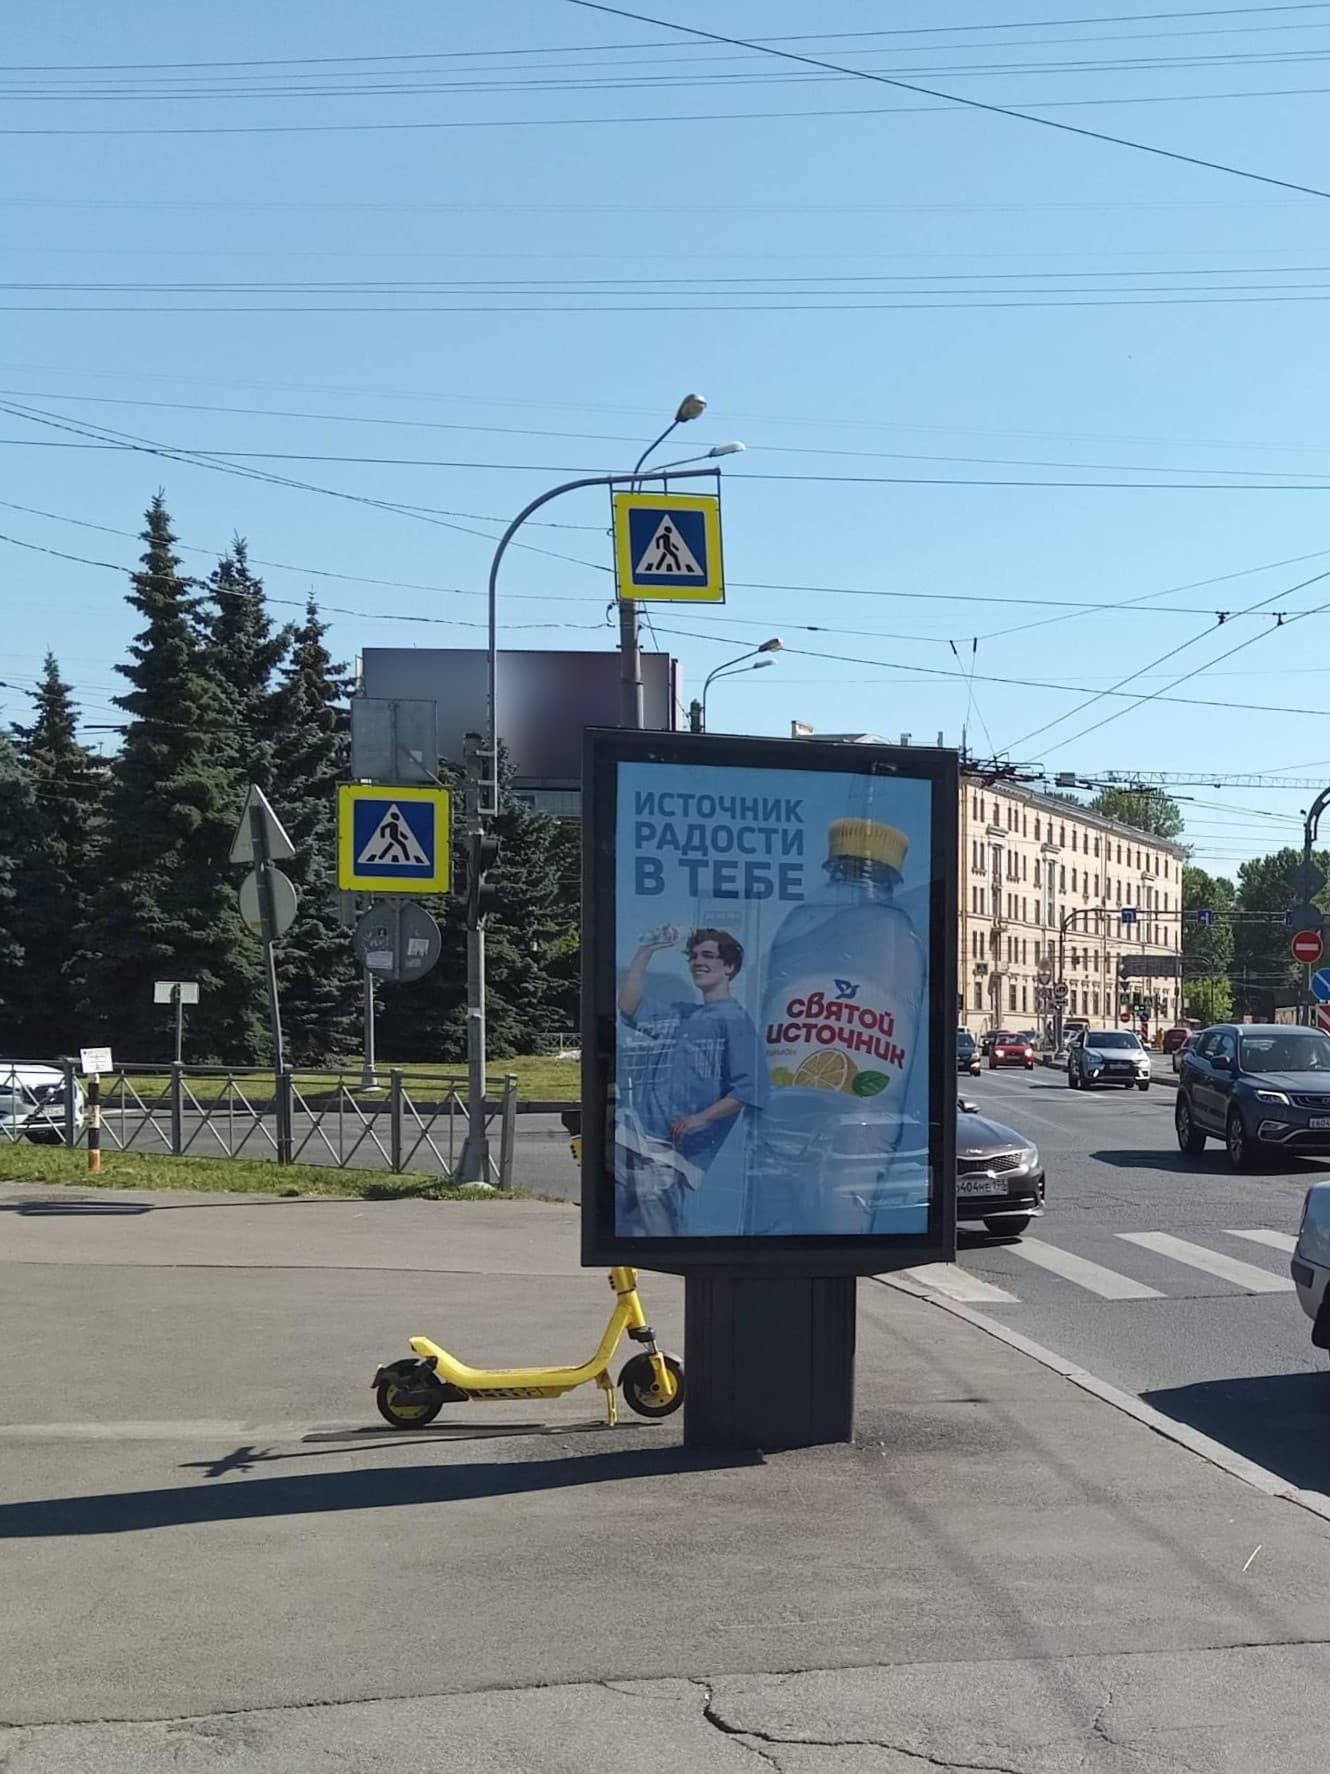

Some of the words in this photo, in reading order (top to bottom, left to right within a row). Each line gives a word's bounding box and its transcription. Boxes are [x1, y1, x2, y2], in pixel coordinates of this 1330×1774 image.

[635, 791, 805, 823] ИСТОЧНИК
[635, 822, 805, 857] РАДОСТИ
[635, 856, 665, 896] В
[678, 858, 805, 901] ТЕБЕ
[786, 991, 896, 1037] СВЯТОЙ
[766, 1022, 906, 1070] ИСТОЧНИК
